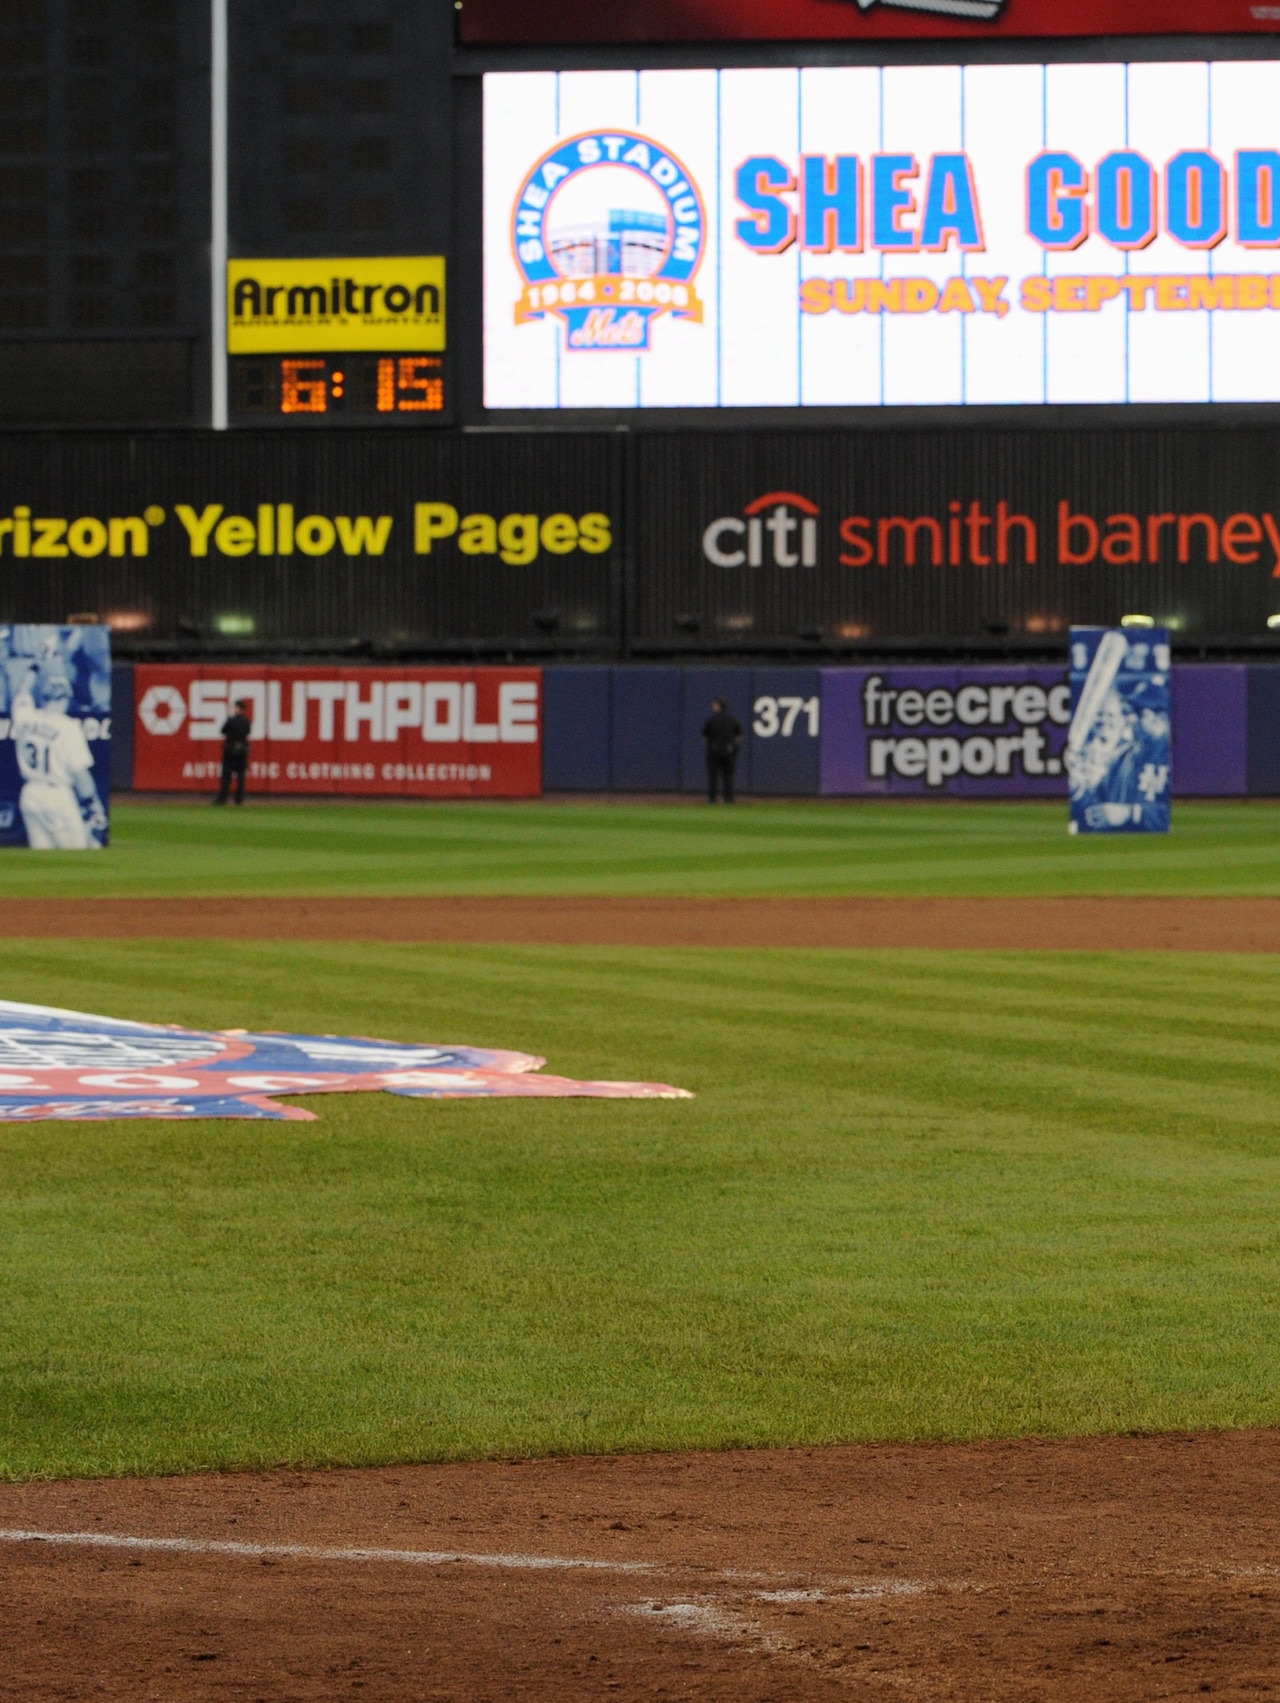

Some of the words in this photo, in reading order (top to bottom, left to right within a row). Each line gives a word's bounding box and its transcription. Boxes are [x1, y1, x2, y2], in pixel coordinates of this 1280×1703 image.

[515, 161, 570, 264] SHEA
[577, 136, 699, 262] STADIUM
[733, 153, 986, 254] SHEA
[234, 277, 440, 316] Armitron
[799, 276, 1010, 320] SUNDAY,
[281, 357, 444, 413] 6:15
[174, 503, 393, 557] Yellow
[414, 502, 612, 565] Pages
[703, 502, 817, 568] citi
[838, 501, 1037, 567] smith
[189, 680, 538, 742] SOUTHPOLE
[752, 696, 820, 738] 371
[286, 762, 375, 781] CLOTHING
[382, 763, 491, 782] COLLECTION
